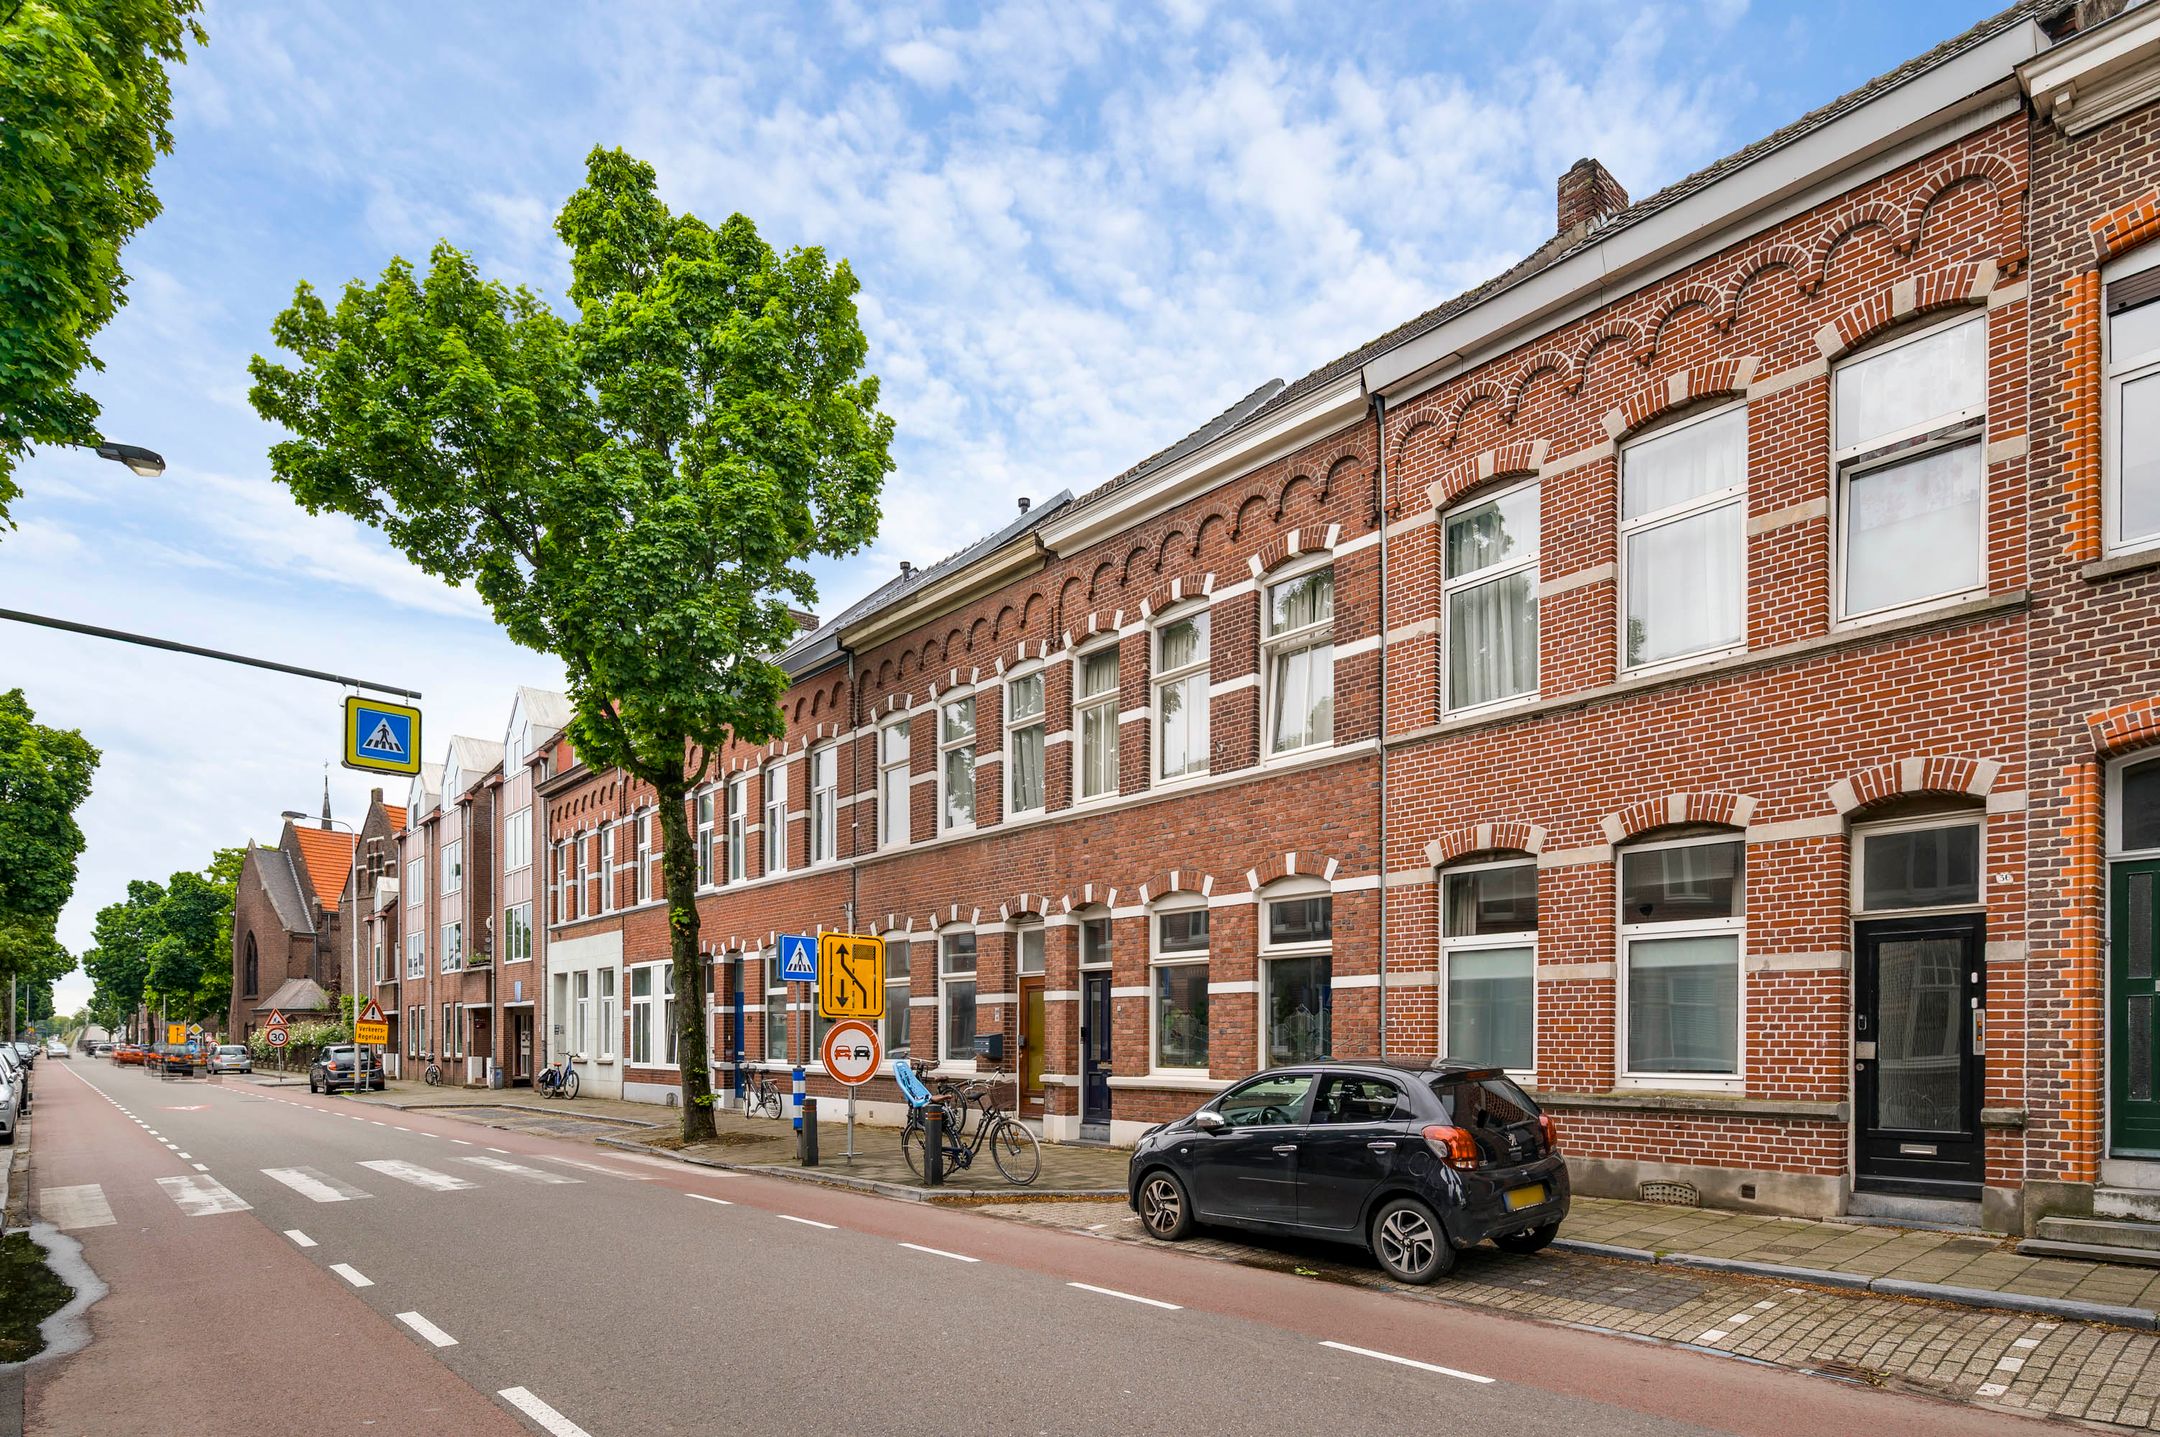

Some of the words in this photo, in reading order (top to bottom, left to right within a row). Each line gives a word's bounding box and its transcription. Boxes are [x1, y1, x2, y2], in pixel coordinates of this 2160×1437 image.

[359, 1025, 385, 1033] Verkeers-
[271, 1033, 285, 1041] 30
[358, 1033, 385, 1041] Regelaars
